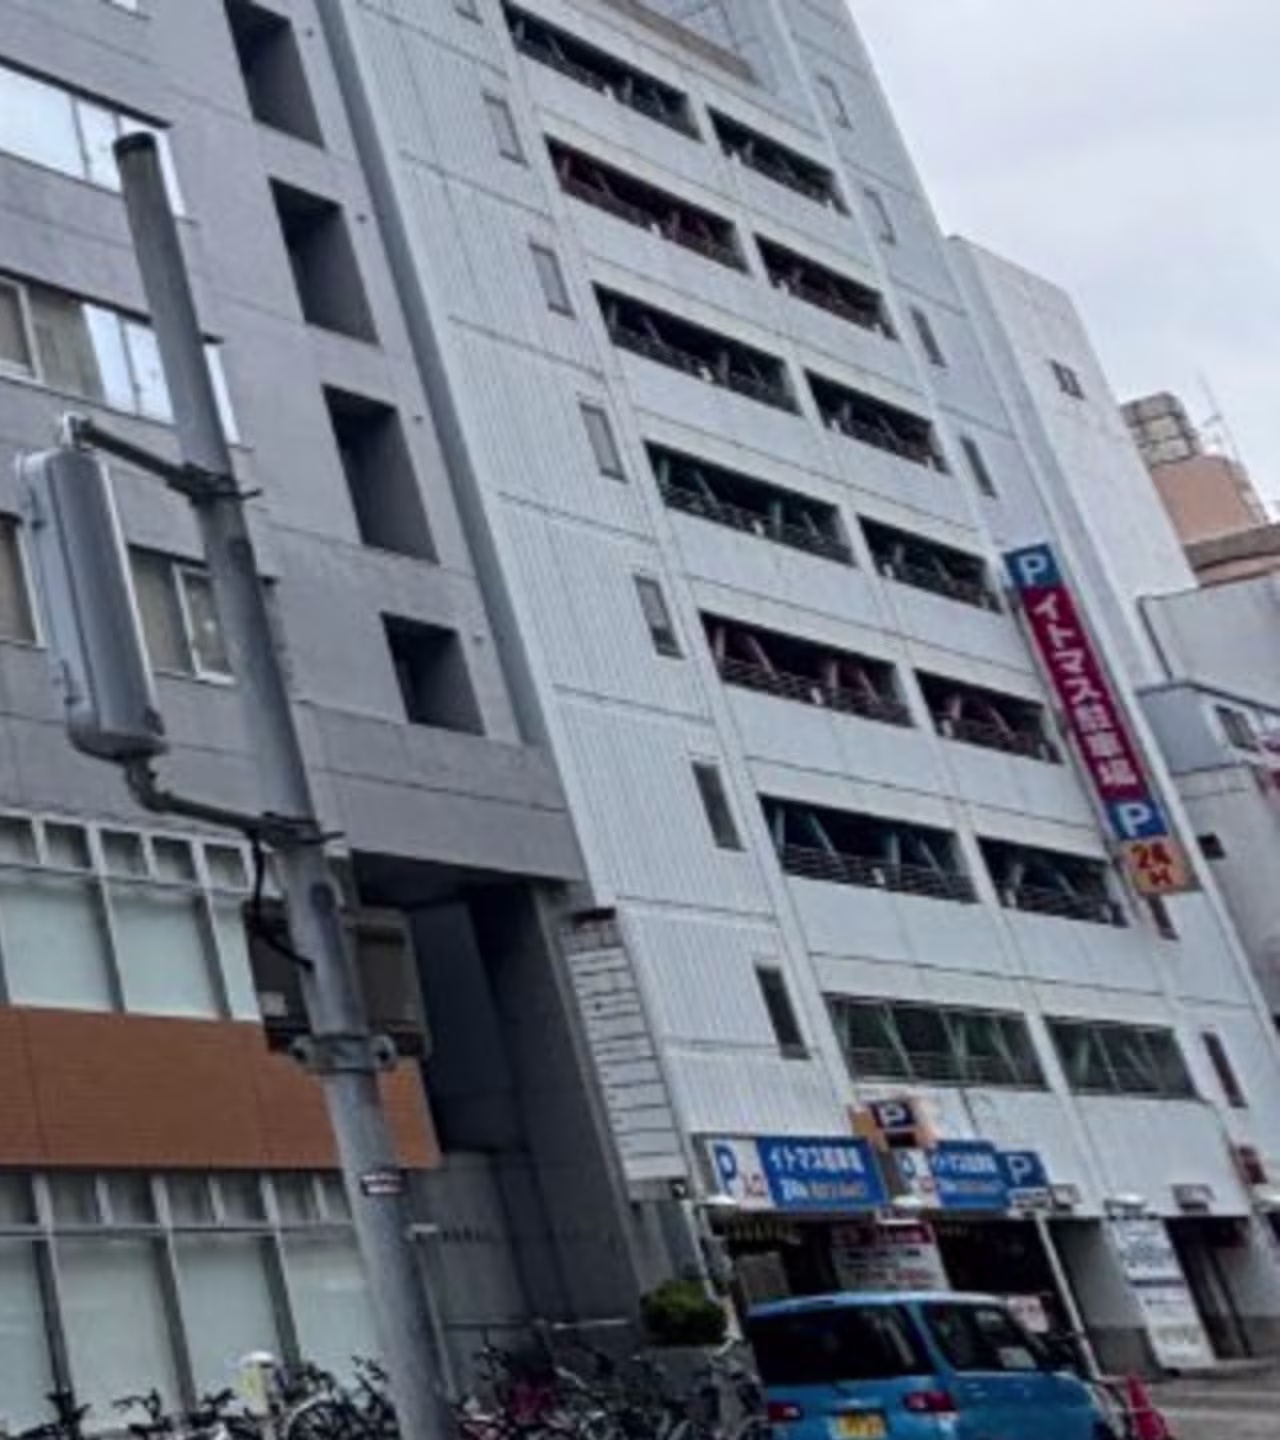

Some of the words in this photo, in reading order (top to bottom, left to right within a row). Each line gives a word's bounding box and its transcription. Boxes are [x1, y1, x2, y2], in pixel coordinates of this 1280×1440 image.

[1017, 553, 1048, 586] P
[1033, 592, 1138, 788] イトマス駐車場
[1119, 802, 1153, 837] P
[1130, 844, 1173, 868] 24
[879, 1104, 906, 1126] P
[714, 1144, 737, 1196] P
[1006, 1155, 1032, 1185] P
